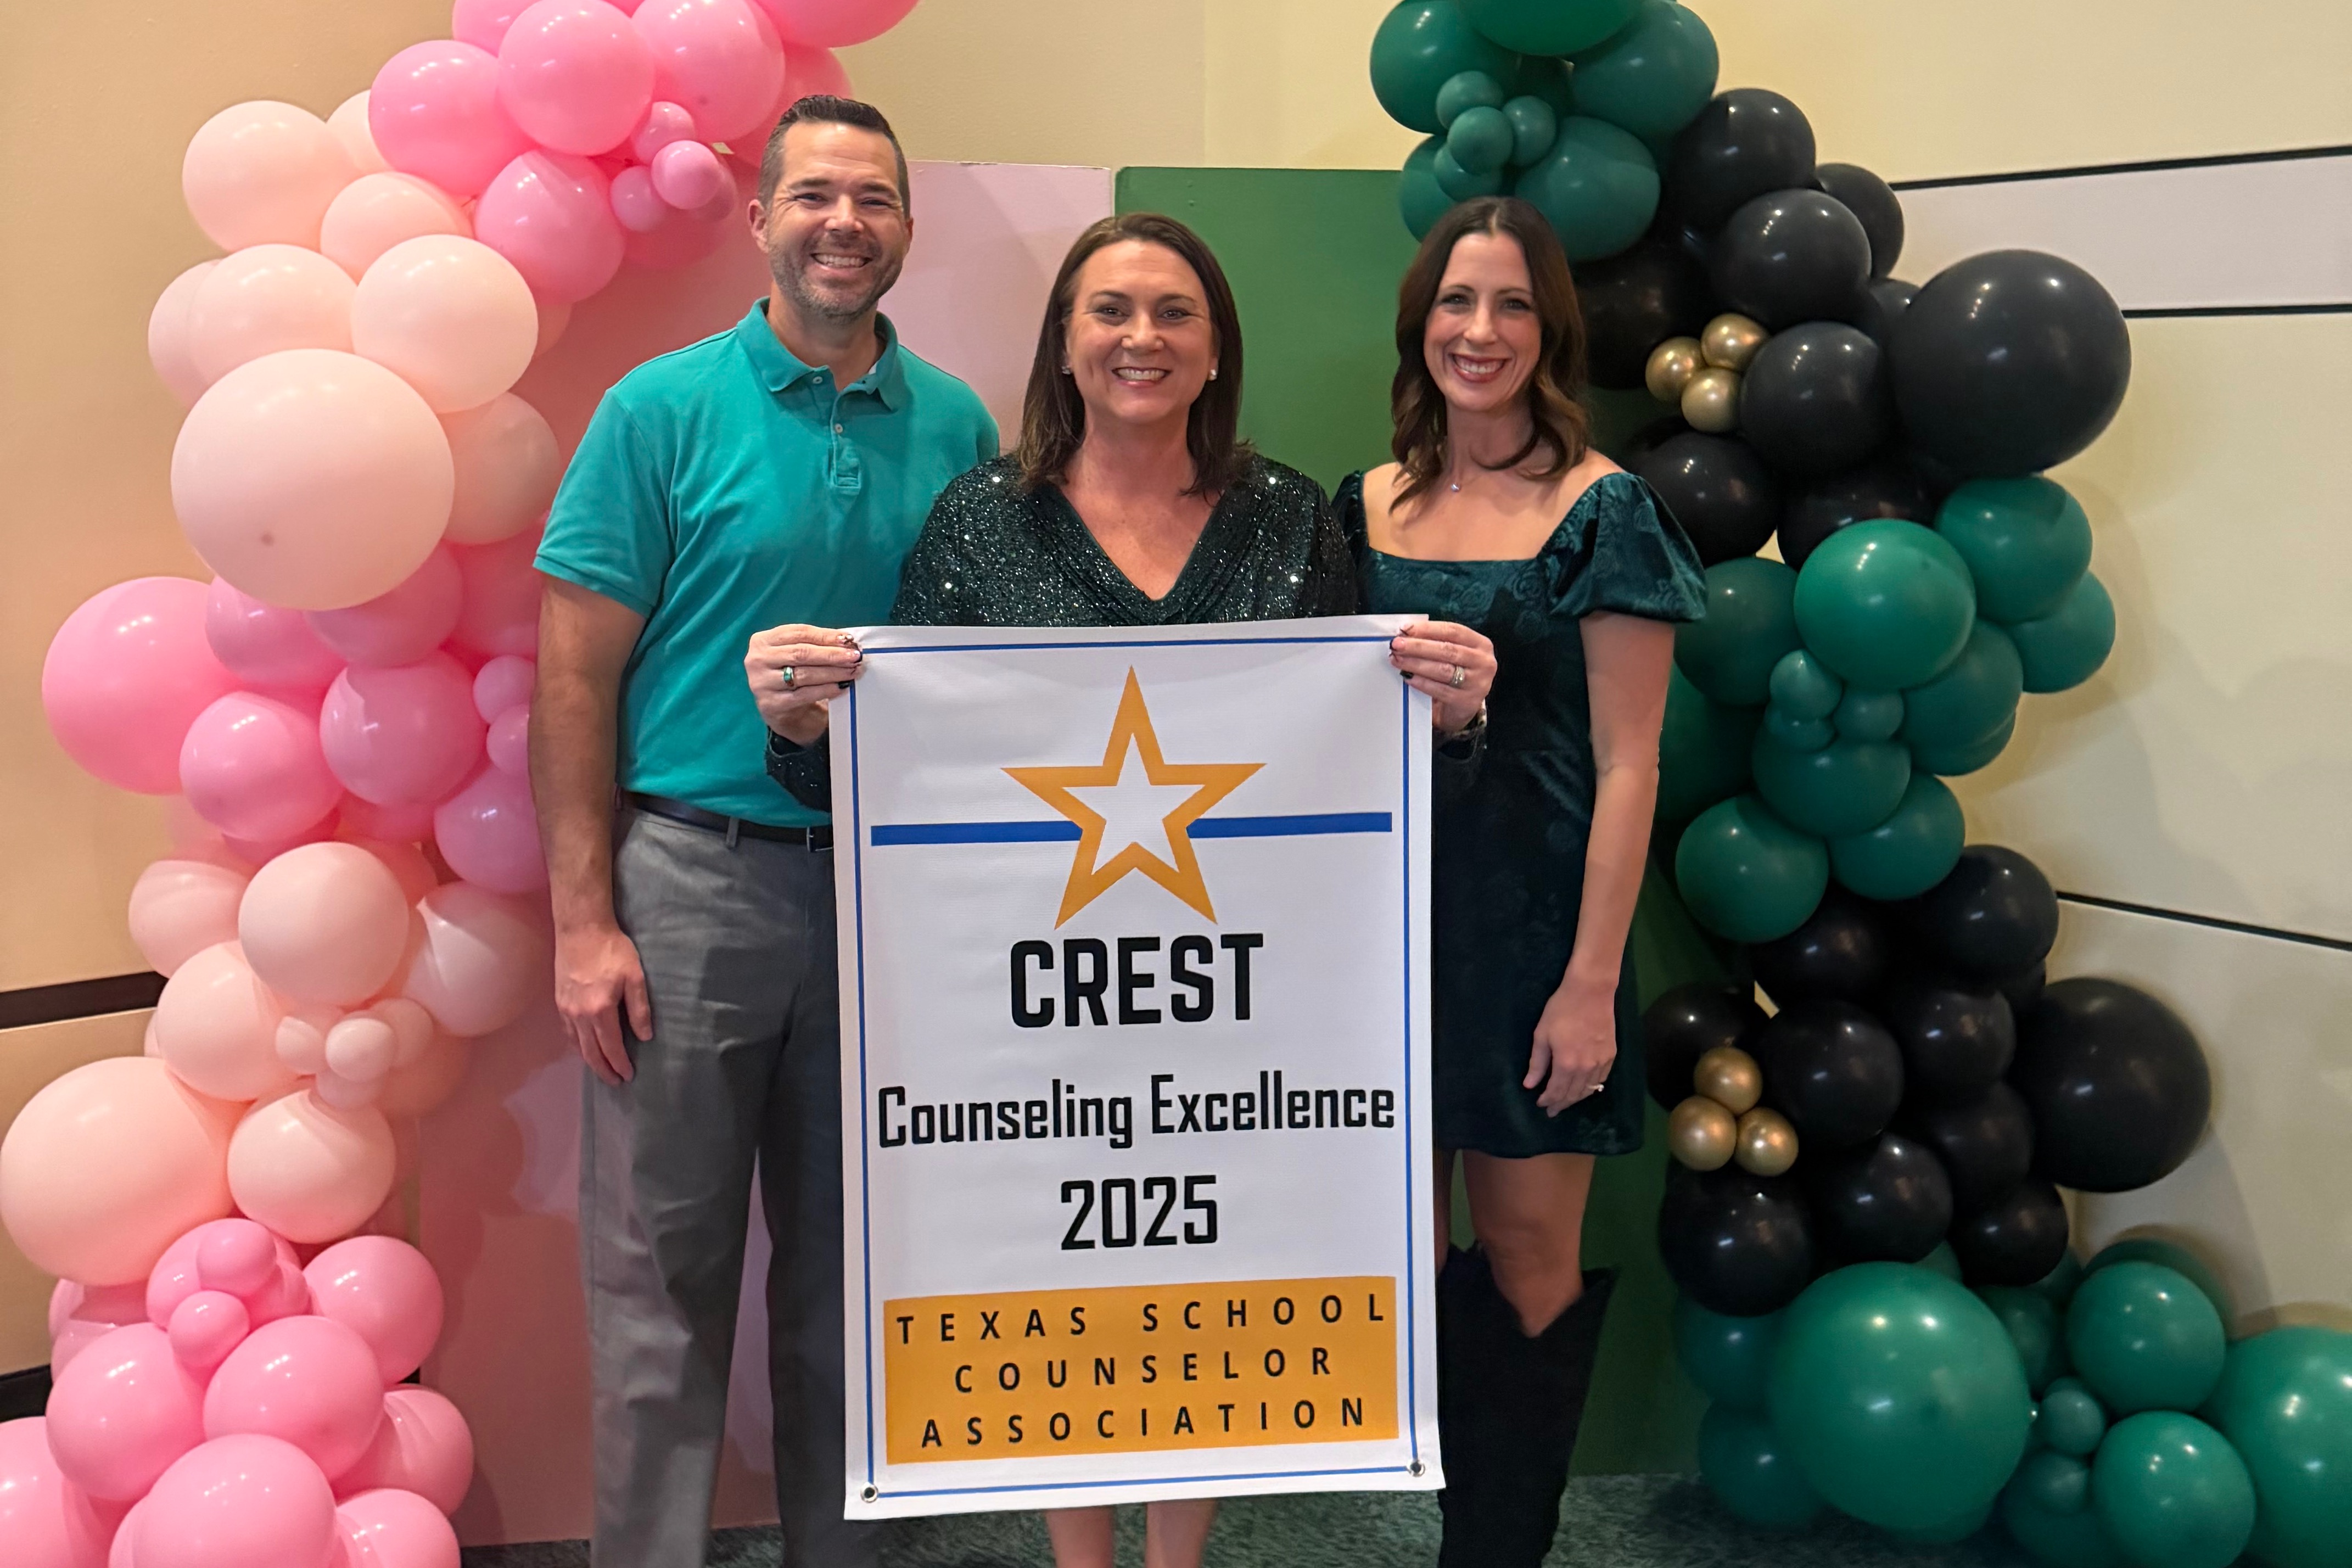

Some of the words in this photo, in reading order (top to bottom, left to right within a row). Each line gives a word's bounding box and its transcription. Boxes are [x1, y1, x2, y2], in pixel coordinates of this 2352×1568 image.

[1011, 933, 1263, 1028] CREST
[879, 1079, 1132, 1149] Counseling
[1151, 1071, 1395, 1134] Excellence
[1061, 1175, 1217, 1250] 2025
[897, 1307, 1085, 1344] TEXAS
[1144, 1294, 1383, 1332] SCHOOL
[955, 1347, 1330, 1393] COUNSELOR
[922, 1398, 1362, 1448] ASSOCIATION
